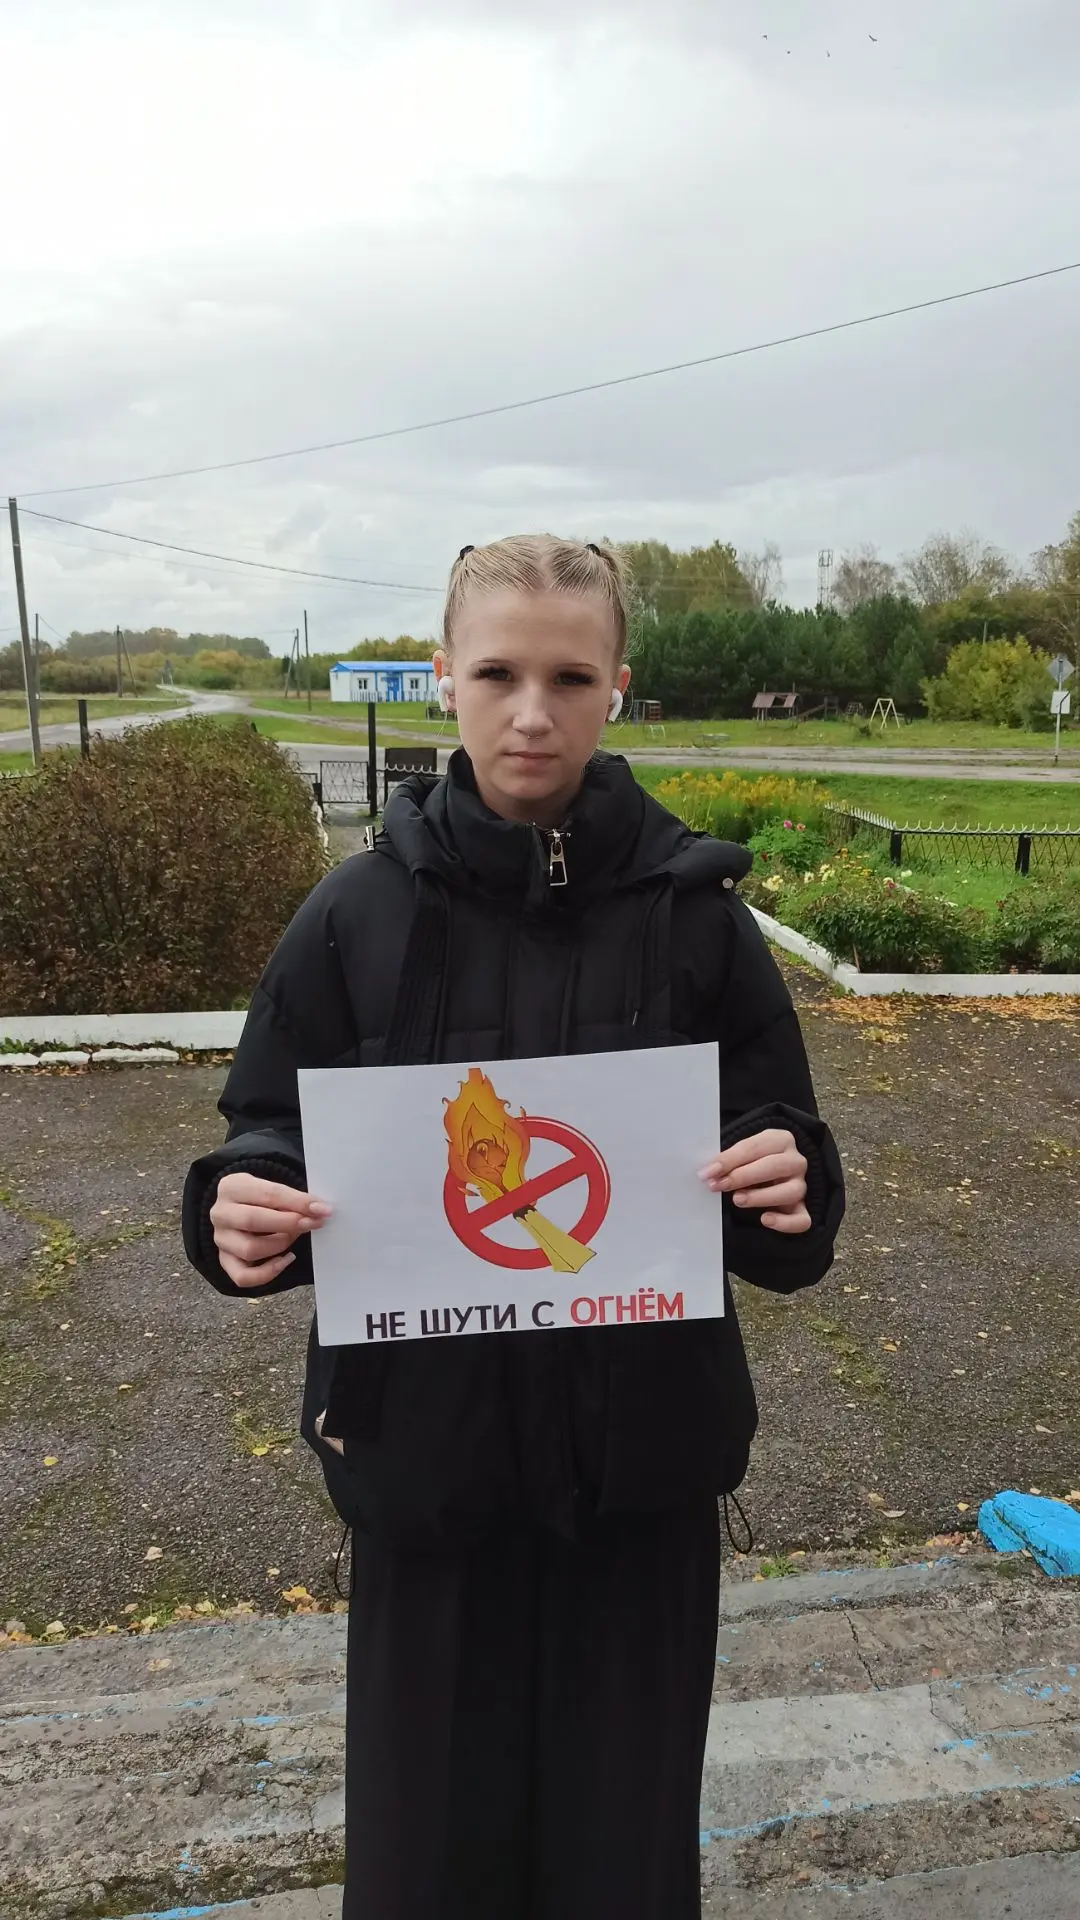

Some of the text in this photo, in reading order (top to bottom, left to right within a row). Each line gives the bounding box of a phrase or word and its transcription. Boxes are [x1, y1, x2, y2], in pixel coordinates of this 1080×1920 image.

[365, 1287, 684, 1339] НЕ ШУТИ С ОГНЁМ
